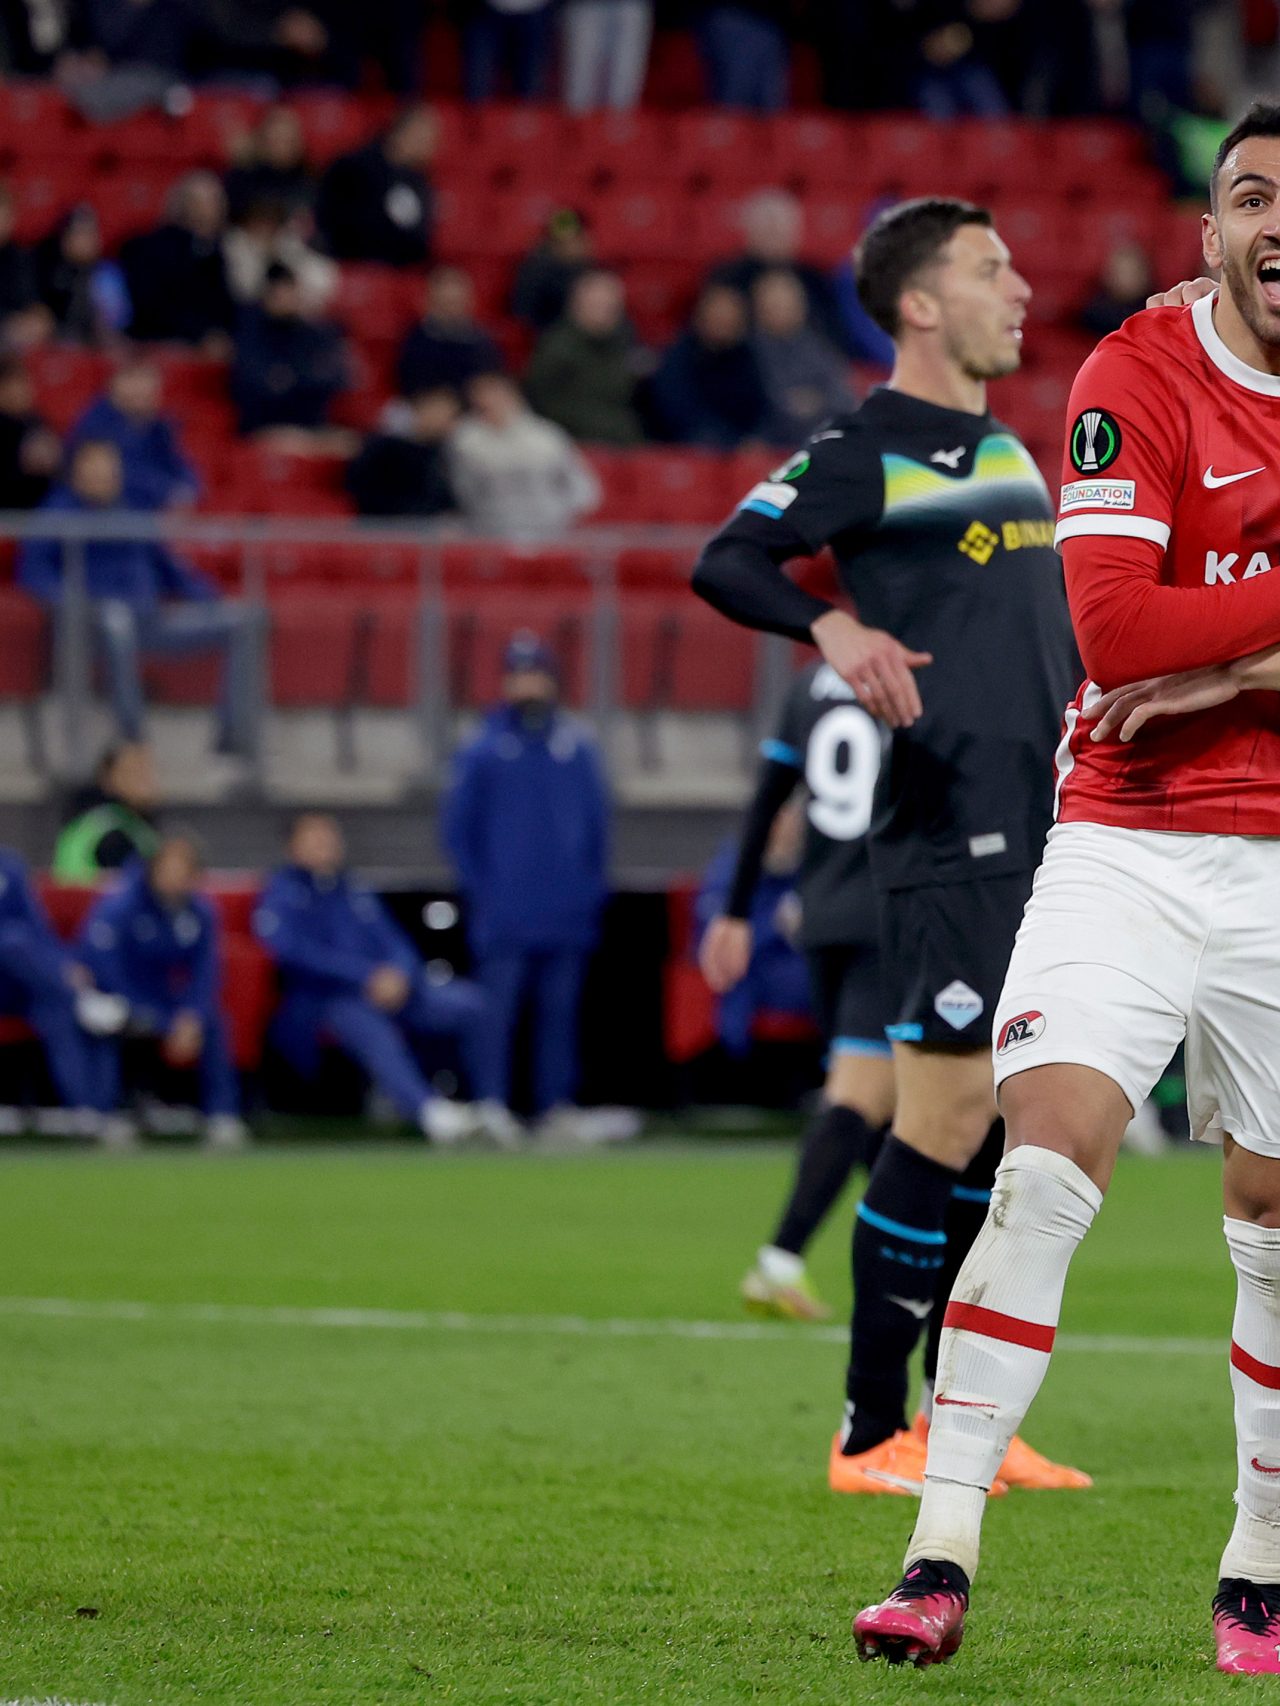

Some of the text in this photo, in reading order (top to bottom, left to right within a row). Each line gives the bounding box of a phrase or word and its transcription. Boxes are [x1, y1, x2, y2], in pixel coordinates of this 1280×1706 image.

[1063, 489, 1132, 502] FOUNDATION
[805, 704, 882, 841] 9
[1004, 1018, 1034, 1048] AZ
